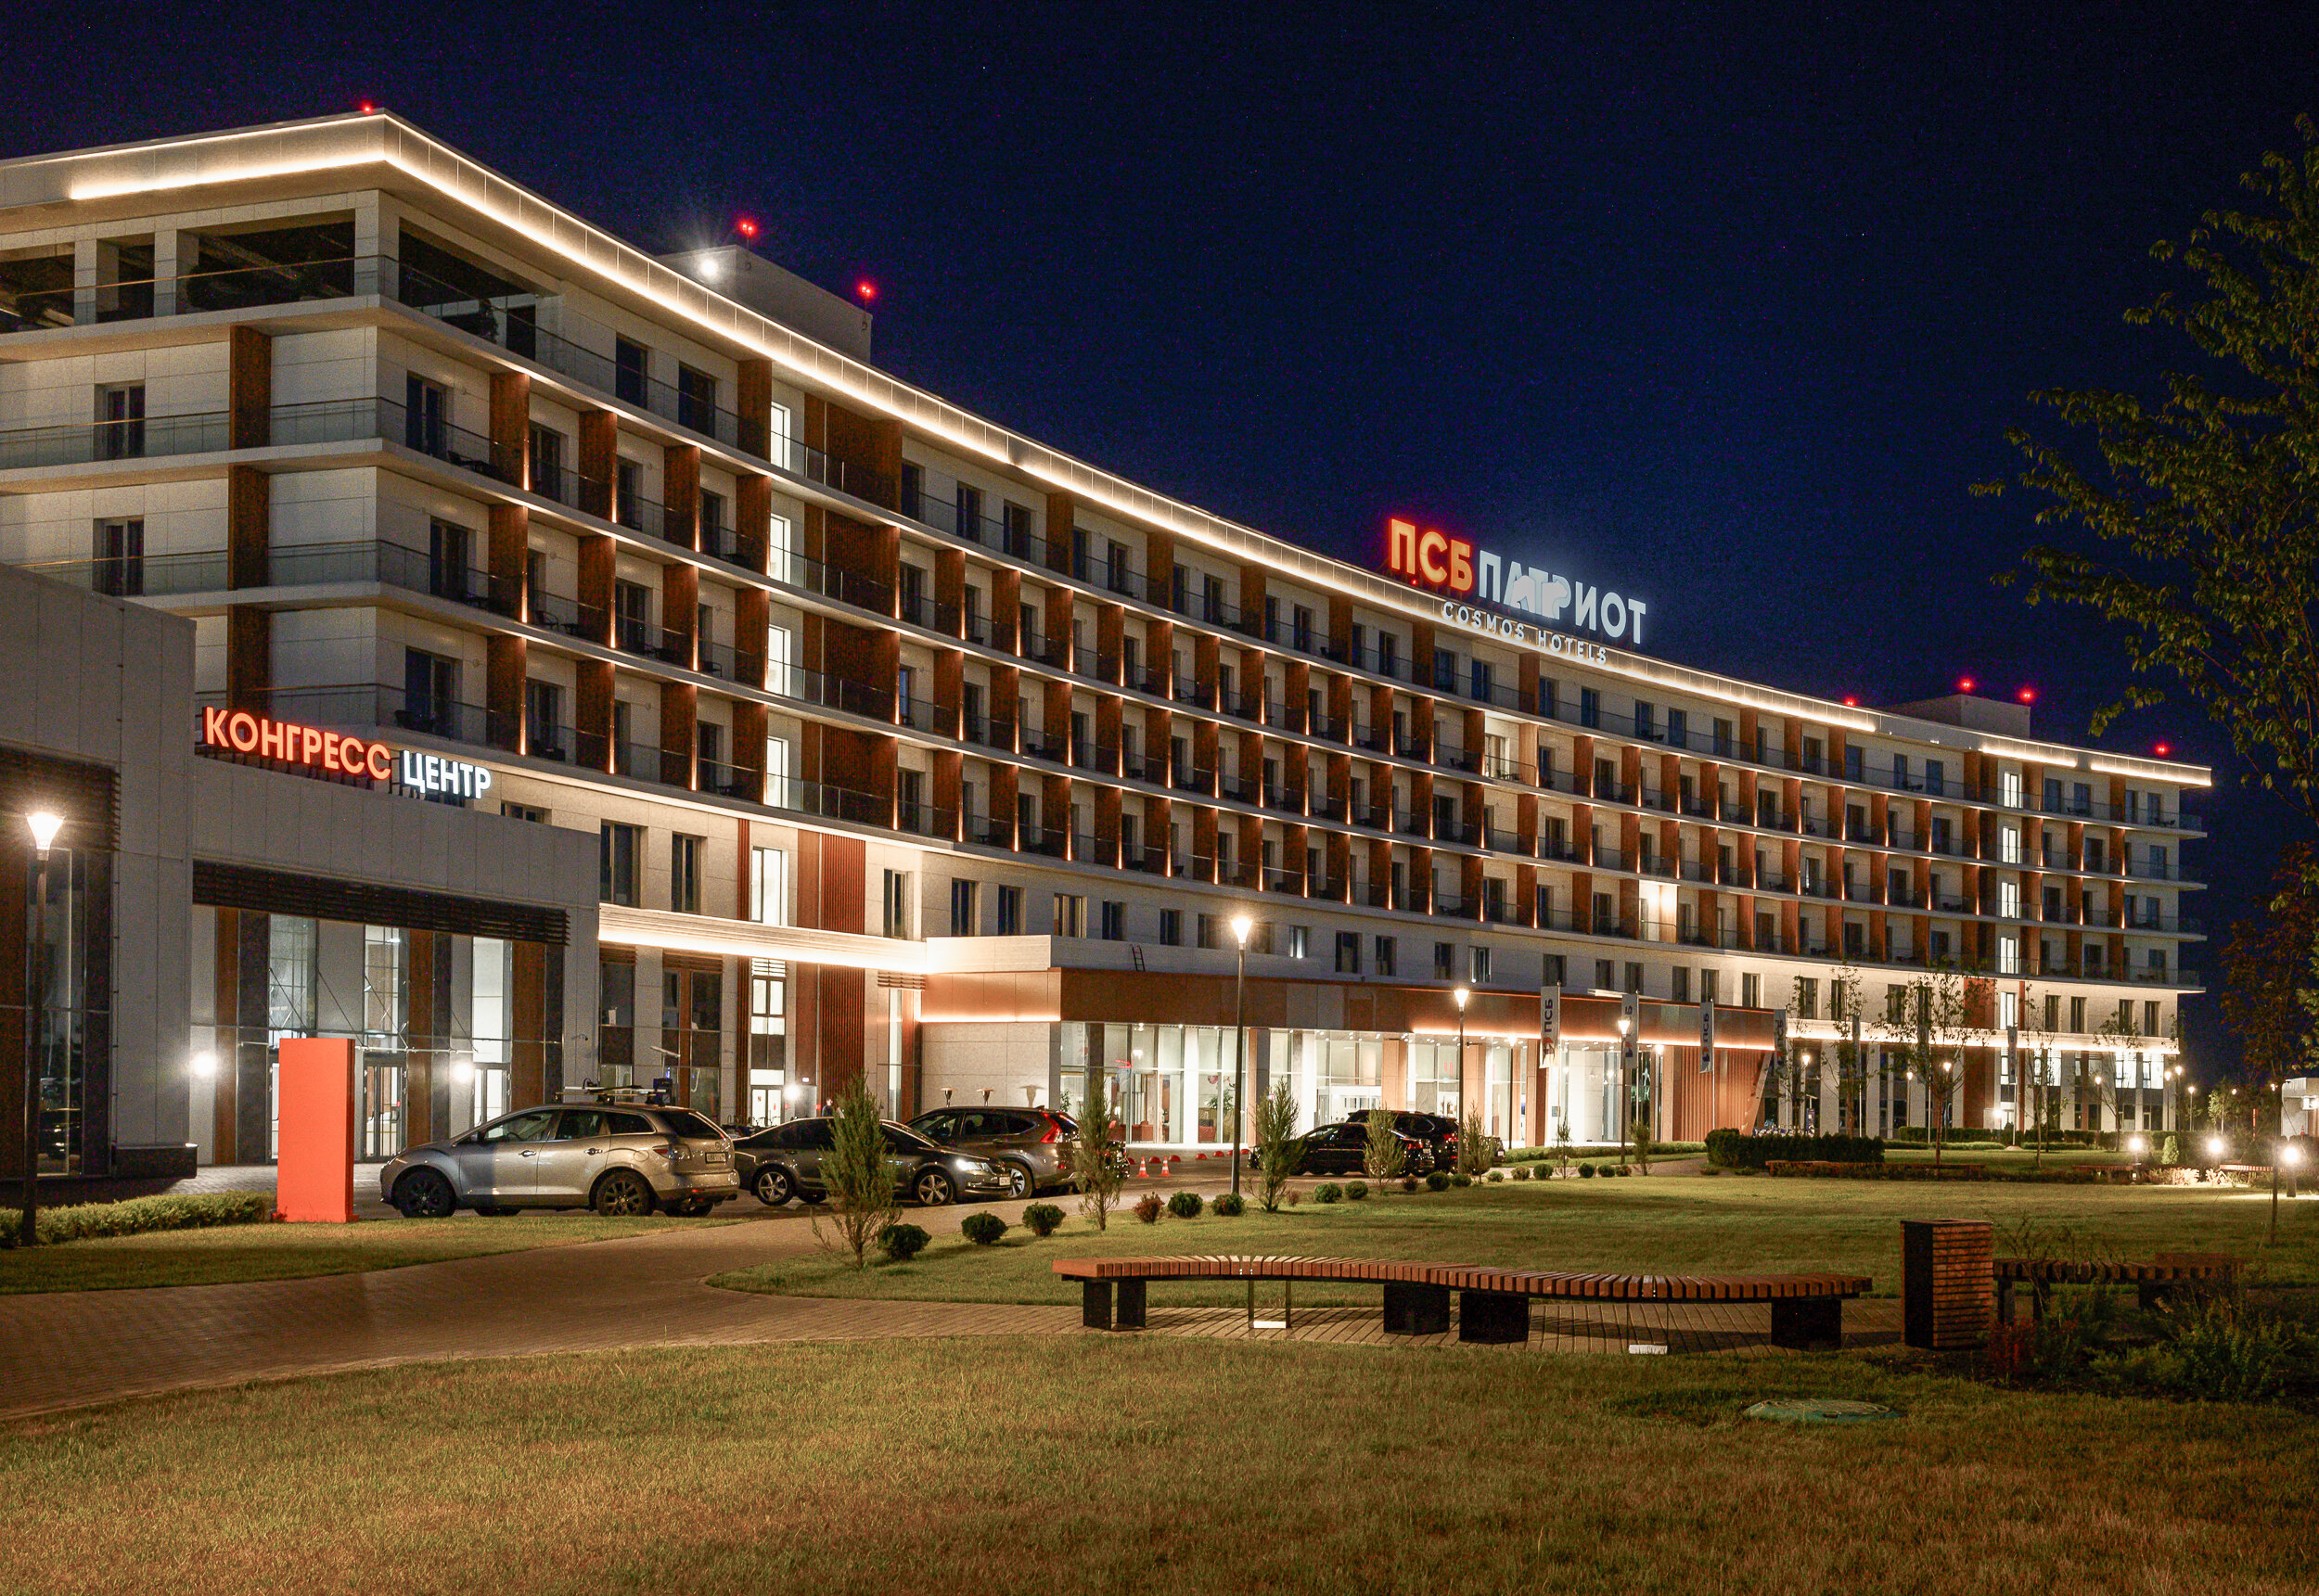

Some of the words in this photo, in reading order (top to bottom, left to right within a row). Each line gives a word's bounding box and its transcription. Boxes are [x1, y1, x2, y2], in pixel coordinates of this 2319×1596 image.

[1389, 518, 1474, 593] ПСБ
[1479, 549, 1647, 645] ПАТРИОТ
[1441, 601, 1526, 642] COSMOS
[1537, 631, 1608, 664] HOTELS
[203, 706, 392, 781] КОНГРЕСС
[402, 749, 493, 800] ЦЕНТР
[1544, 999, 1554, 1033] ПСБ
